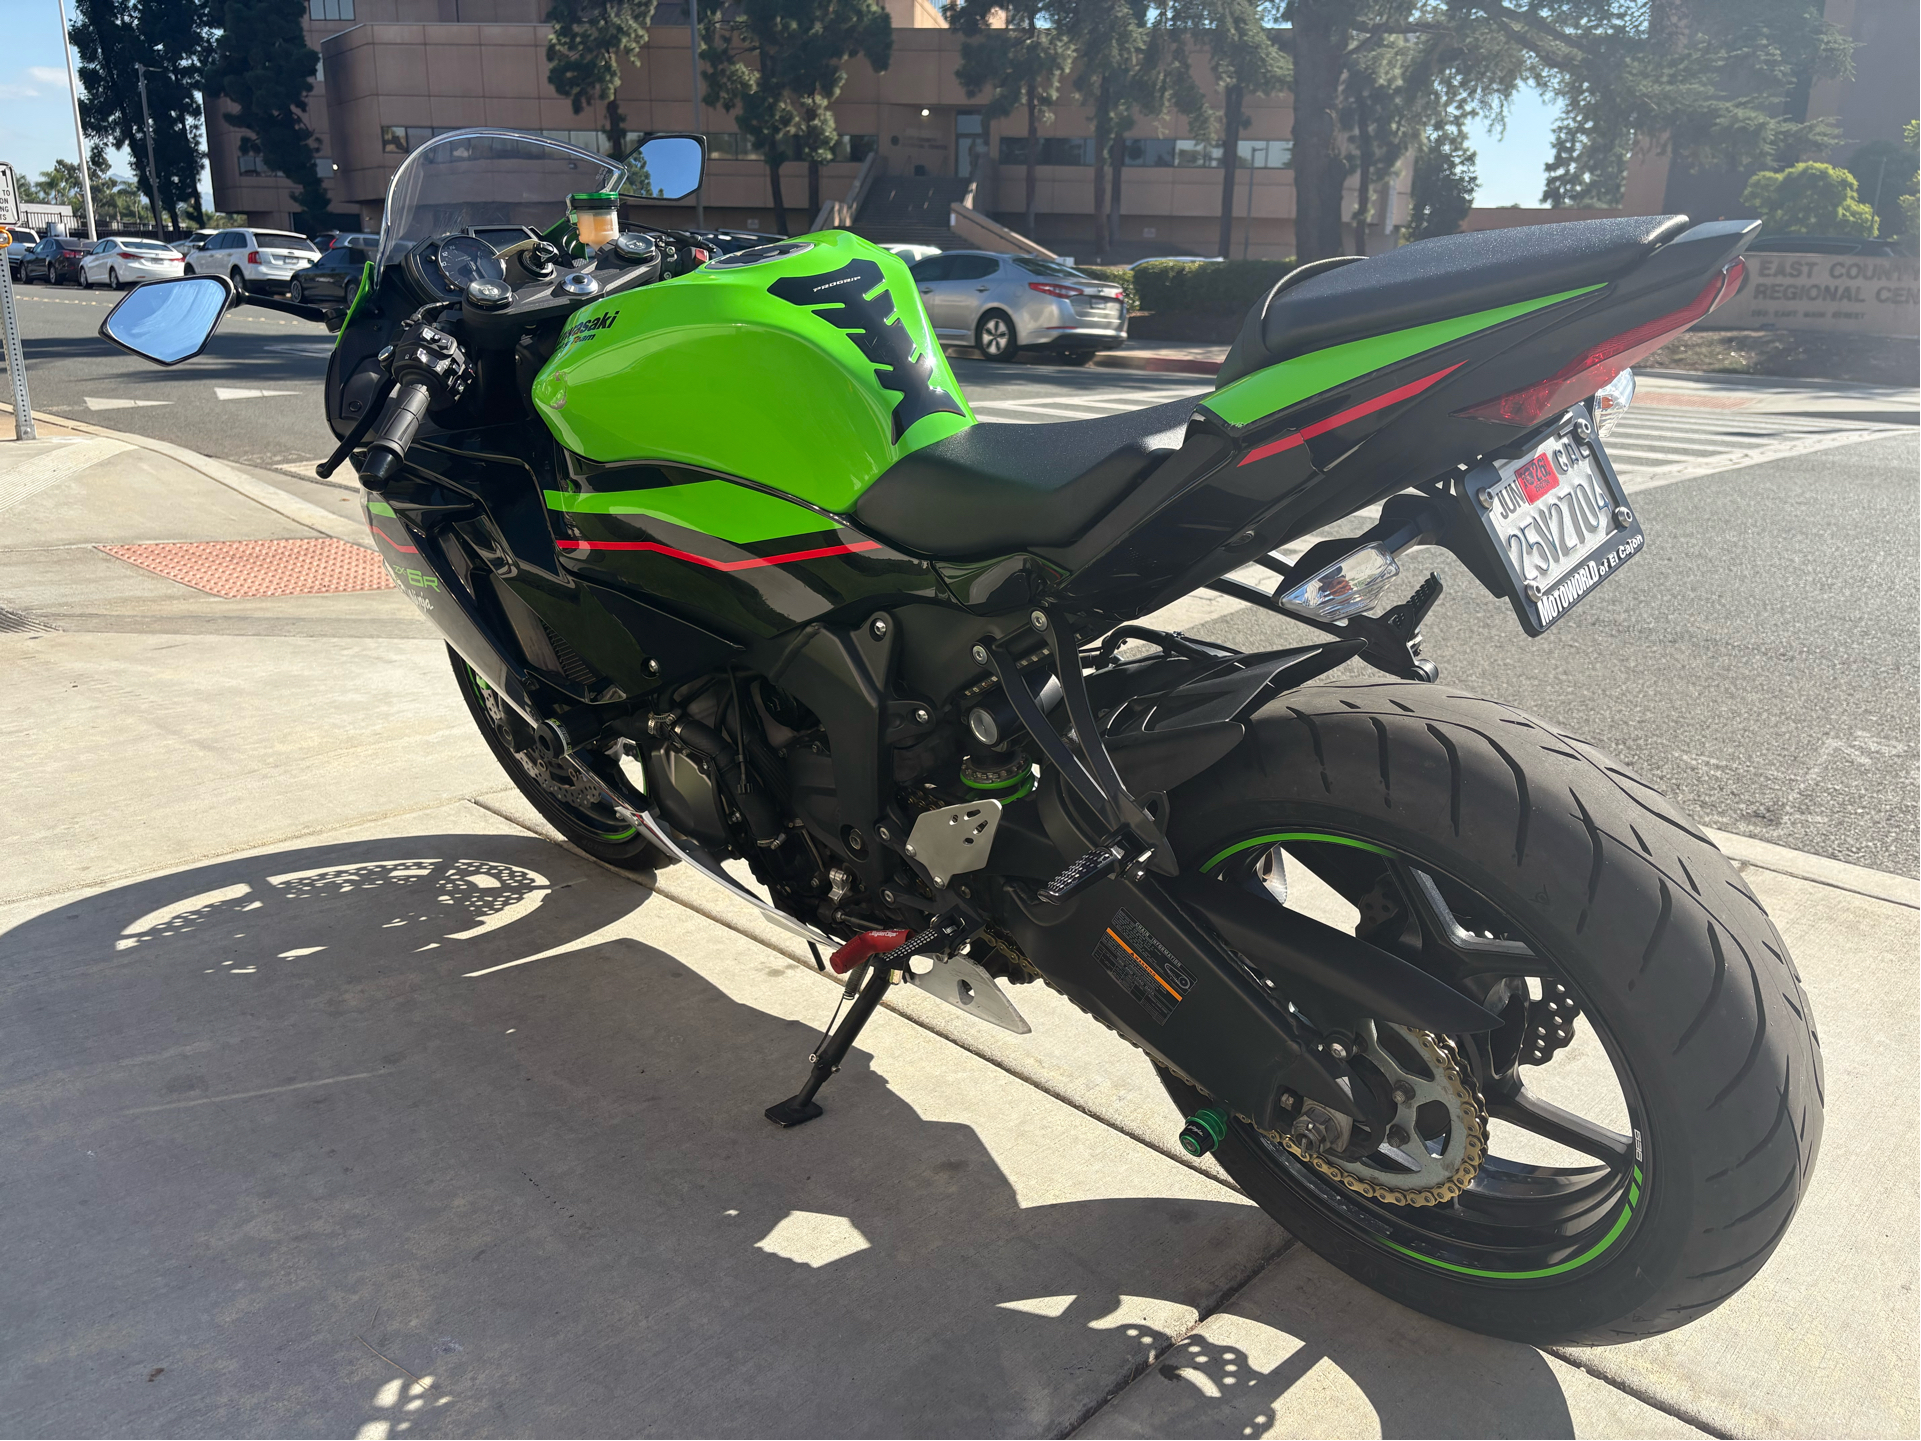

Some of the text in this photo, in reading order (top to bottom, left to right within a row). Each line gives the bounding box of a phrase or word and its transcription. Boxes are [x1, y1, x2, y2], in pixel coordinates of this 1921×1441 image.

[1758, 260, 1818, 278] EAST
[1754, 283, 1866, 303] REGIONAL
[556, 310, 620, 344] wasaki
[1554, 440, 1590, 472] CAL
[1496, 479, 1526, 520] JUN
[1531, 458, 1548, 481] 26
[1508, 473, 1612, 580] 25V2704
[1537, 534, 1643, 626] MOTOWORLD of El Cajon
[1134, 956, 1156, 976] WARNING
